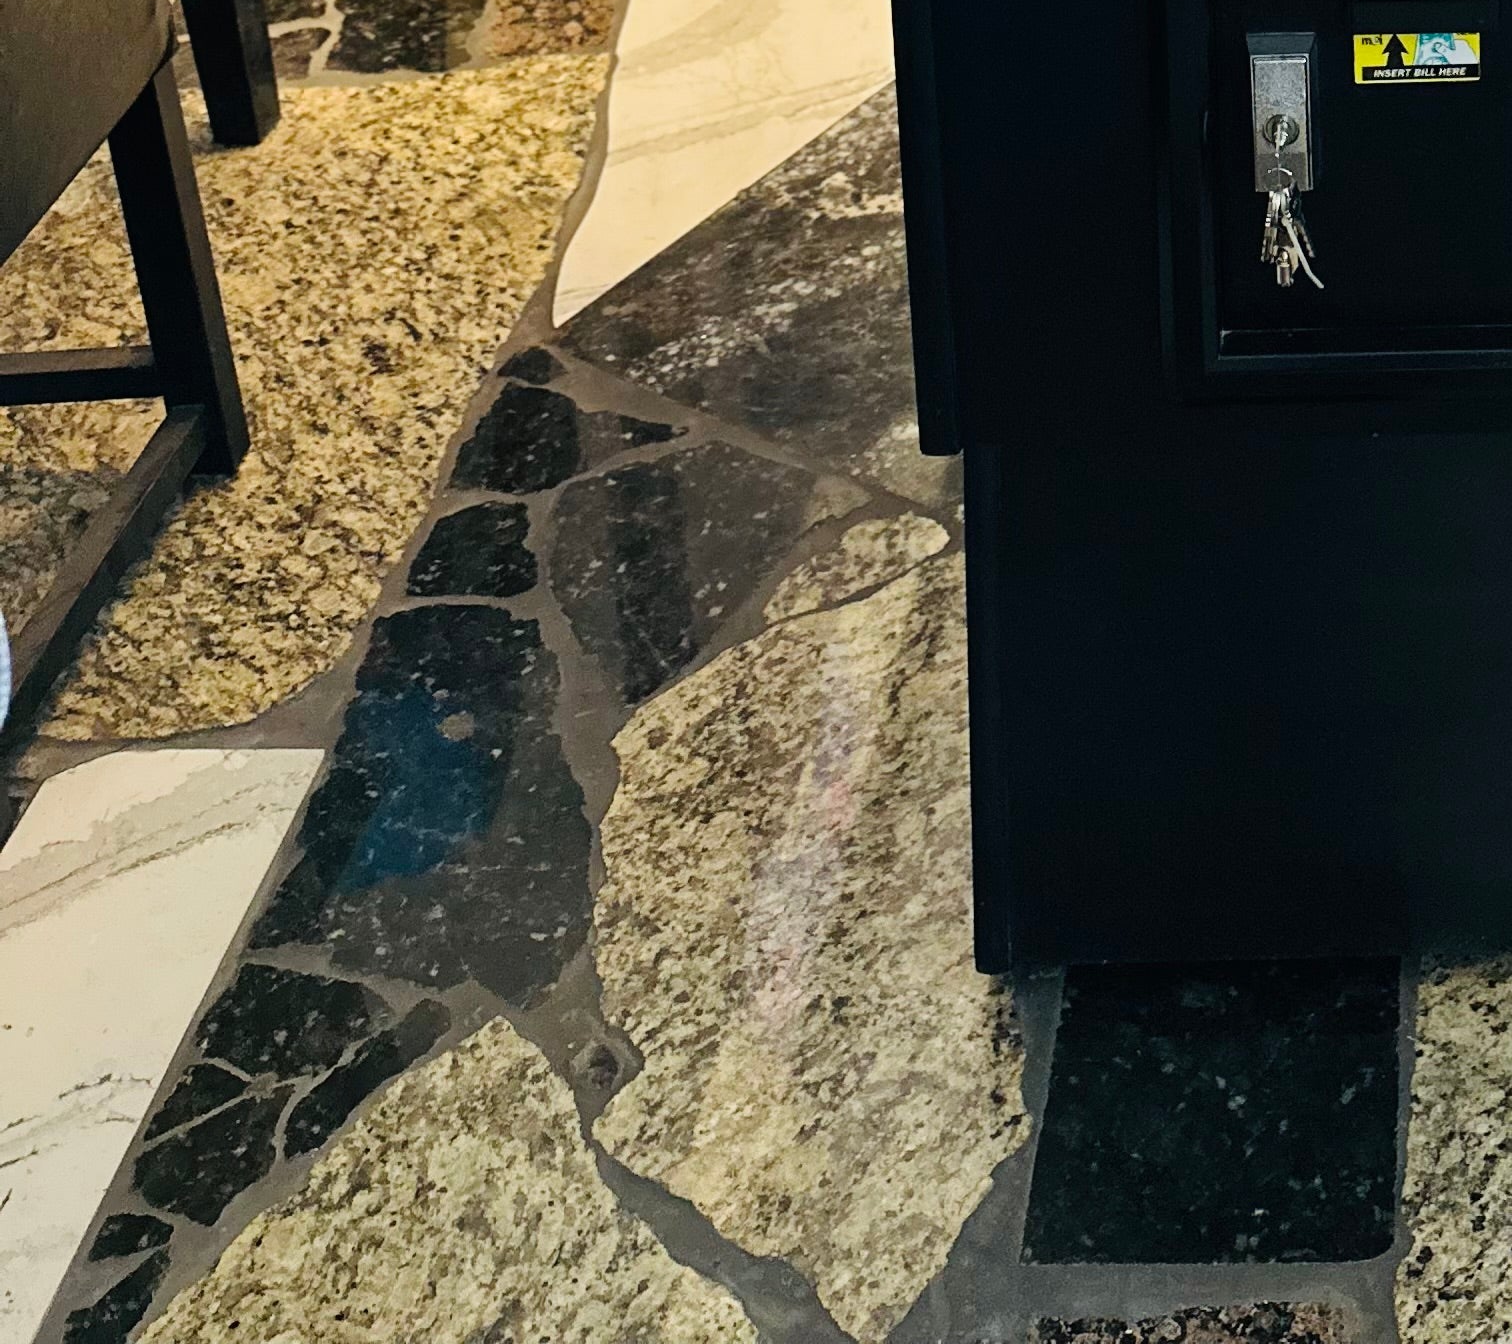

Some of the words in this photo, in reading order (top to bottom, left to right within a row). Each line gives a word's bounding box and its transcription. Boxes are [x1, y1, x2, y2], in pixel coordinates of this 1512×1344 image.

[1373, 68, 1411, 78] INSERT
[1413, 68, 1436, 77] BILL
[1438, 67, 1467, 77] HERE
